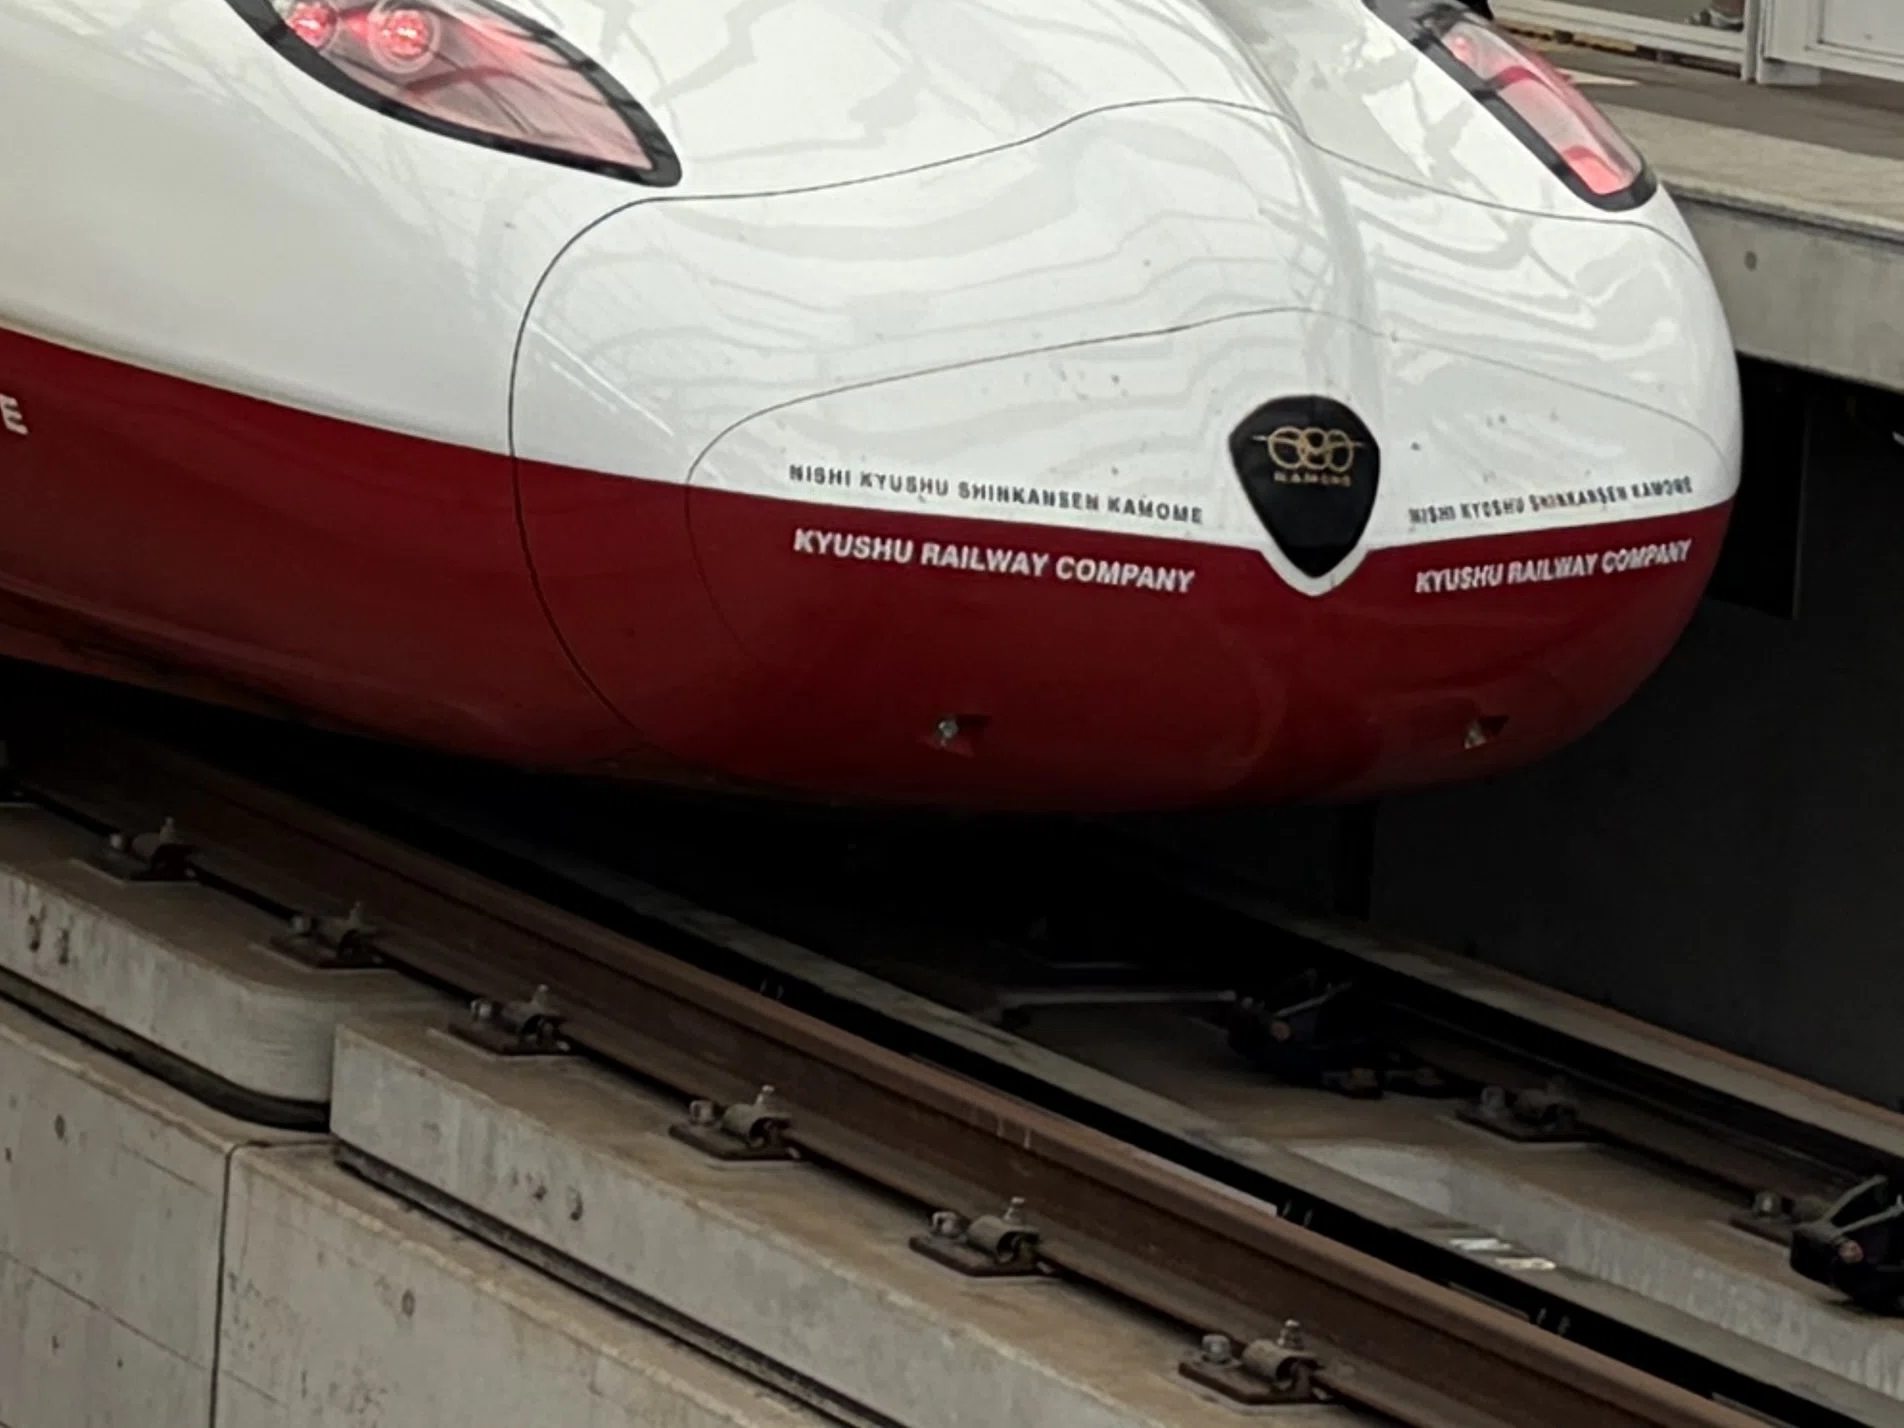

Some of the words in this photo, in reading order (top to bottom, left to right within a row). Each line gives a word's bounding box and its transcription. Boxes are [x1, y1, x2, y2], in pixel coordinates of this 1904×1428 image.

[789, 463, 852, 487] NISHI
[859, 470, 950, 497] KYUSHU
[957, 481, 1101, 513] SHINKANSEN
[1106, 494, 1204, 526] KAMOME
[1408, 504, 1457, 526] NISHI
[1460, 496, 1526, 522] KYUSHU
[1528, 485, 1629, 514] SHINKANSEN
[1630, 475, 1694, 502] KAMOME
[793, 527, 915, 566] KYUSHU
[920, 542, 1050, 579] RAILWAY
[1055, 555, 1196, 594] COMPANY
[1414, 559, 1505, 595] KYUSHU
[1506, 552, 1599, 587] RAILWAY
[1601, 538, 1694, 575] COMPANY
